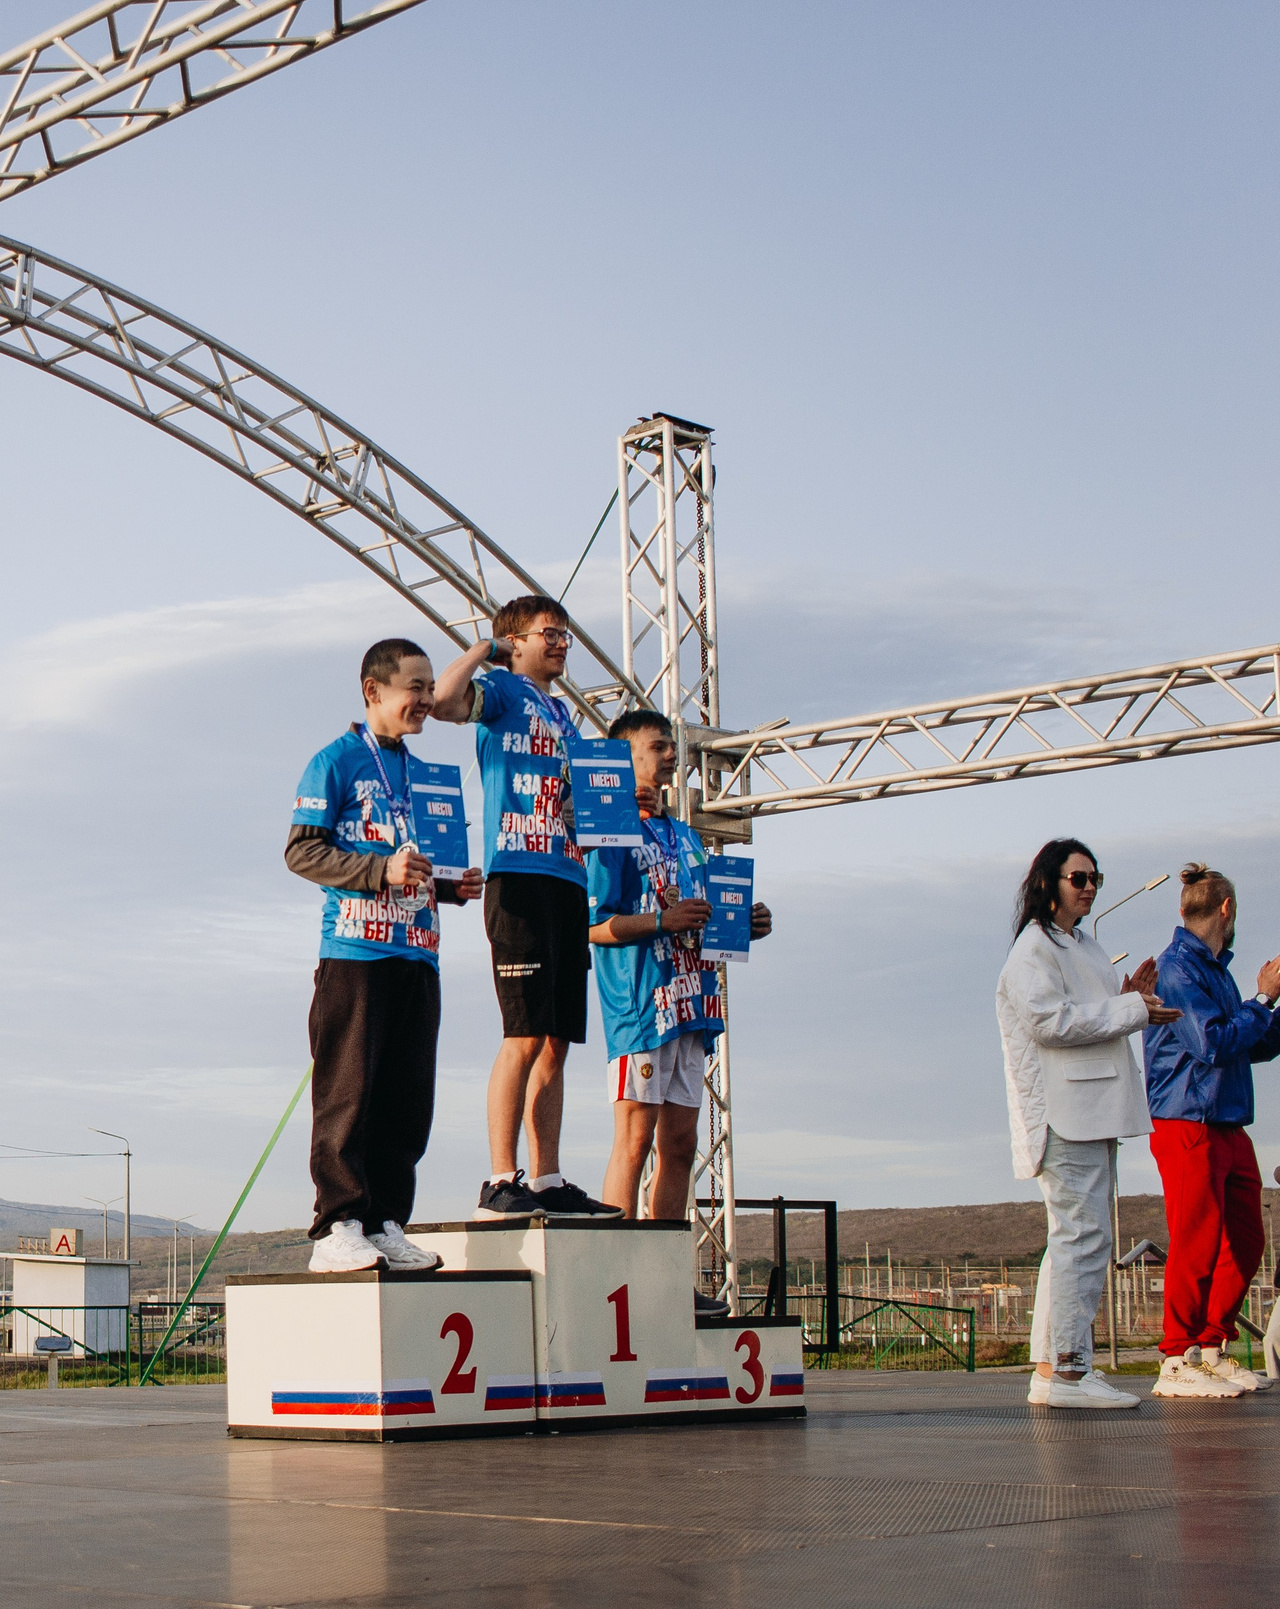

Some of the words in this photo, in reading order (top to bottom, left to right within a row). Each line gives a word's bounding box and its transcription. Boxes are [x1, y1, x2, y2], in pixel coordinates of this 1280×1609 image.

[502, 731, 558, 758] #ЗАБЕГ
[512, 772, 565, 798] #ЗАБЕГ
[596, 773, 621, 788] МЕСТО
[302, 796, 328, 811] ПСБ
[497, 832, 553, 854] #ЗАБЕГ
[631, 842, 665, 872] 202
[334, 918, 394, 944] #ЗАБЕГ
[607, 1284, 638, 1362] 1
[440, 1312, 478, 1395] 2
[735, 1329, 764, 1404] 3
